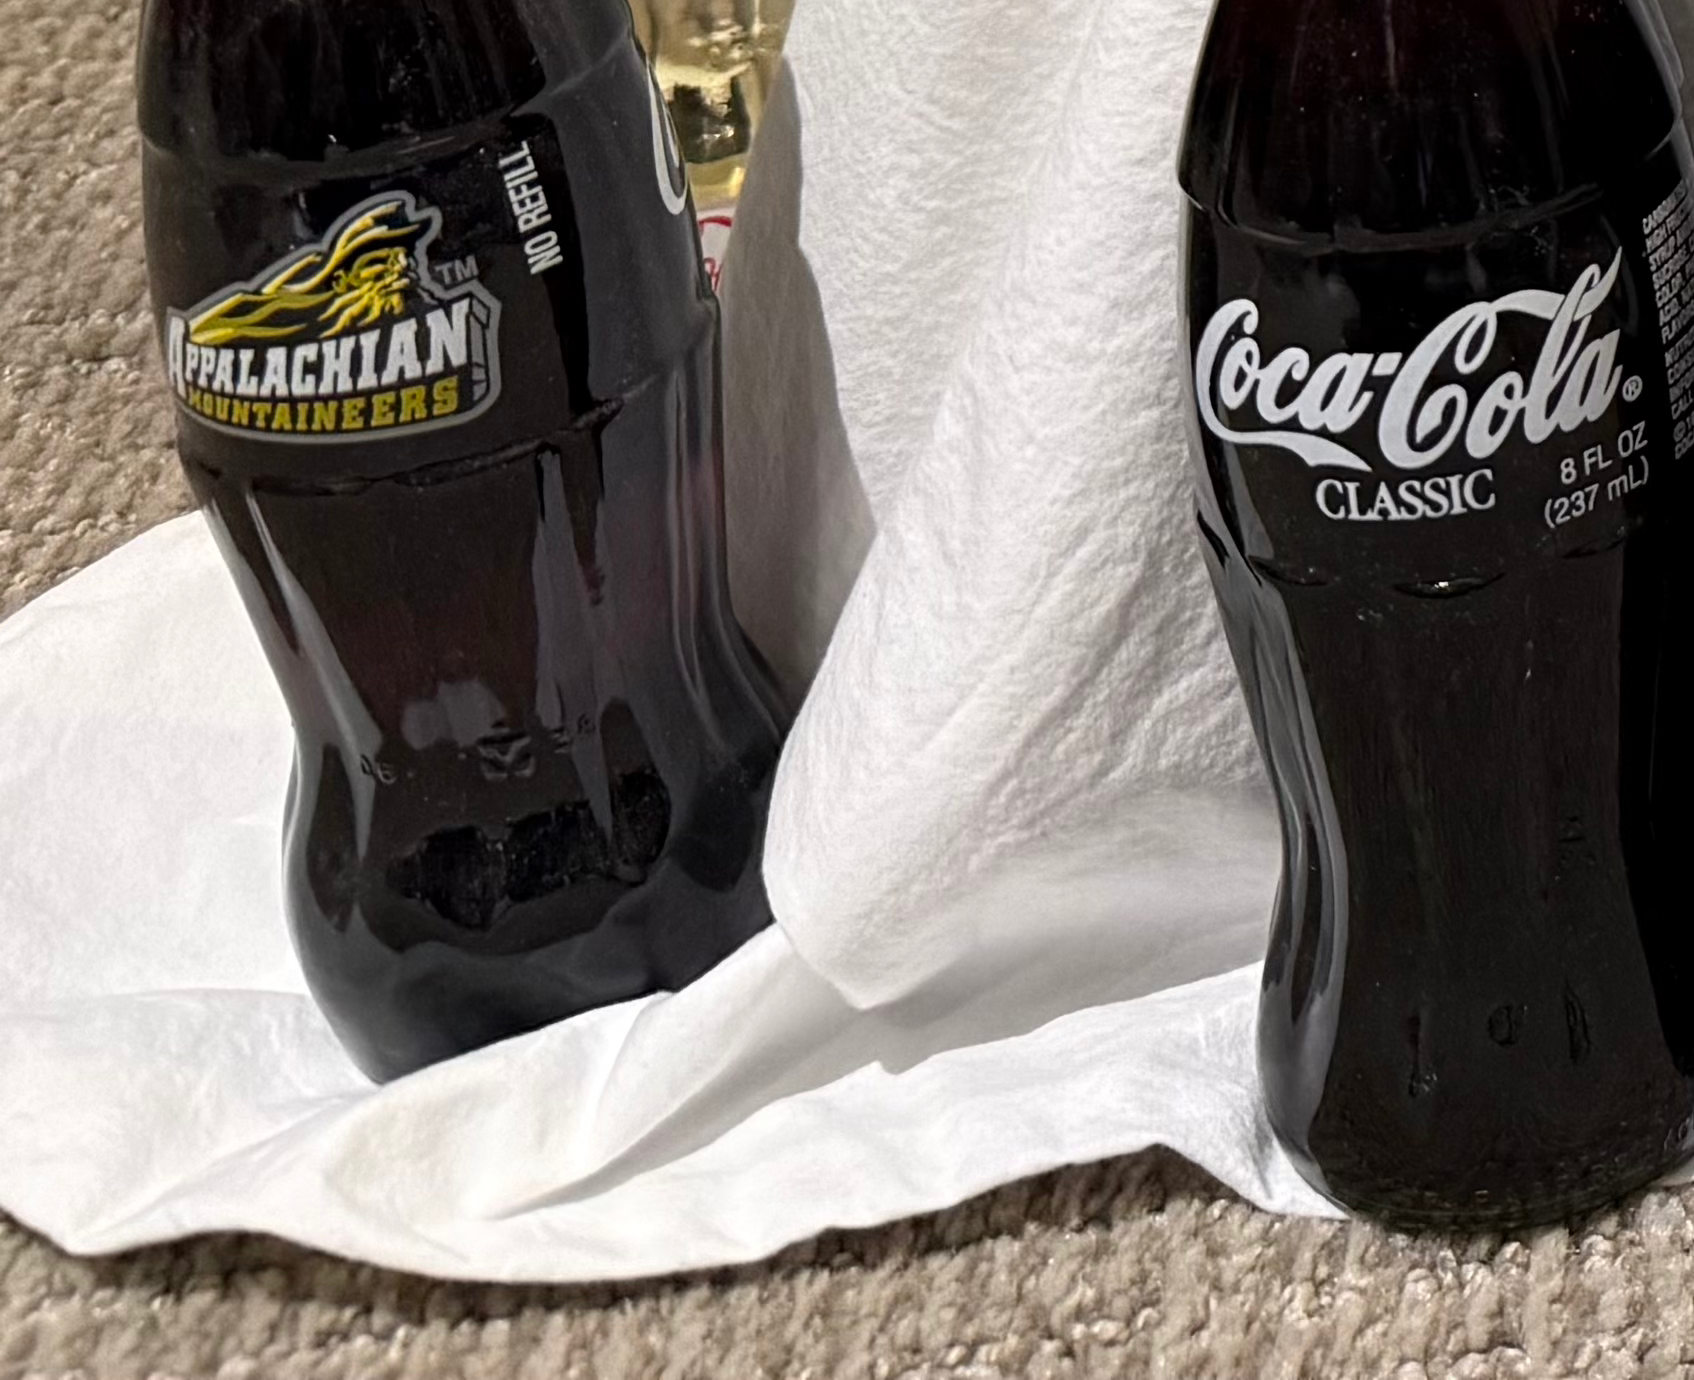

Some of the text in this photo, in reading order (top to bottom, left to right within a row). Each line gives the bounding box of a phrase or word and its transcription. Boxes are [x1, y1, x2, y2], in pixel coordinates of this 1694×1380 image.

[499, 140, 565, 276] NO REFILL
[435, 256, 479, 286] TM
[166, 298, 476, 401] APPALACHIAN
[1199, 246, 1623, 472] Coca-Cola
[187, 374, 460, 433] MOUNTAINEERS
[1560, 421, 1649, 486] 8 FL OZ
[1316, 468, 1496, 521] CLASSIC
[1544, 457, 1650, 530] (237 mL)
